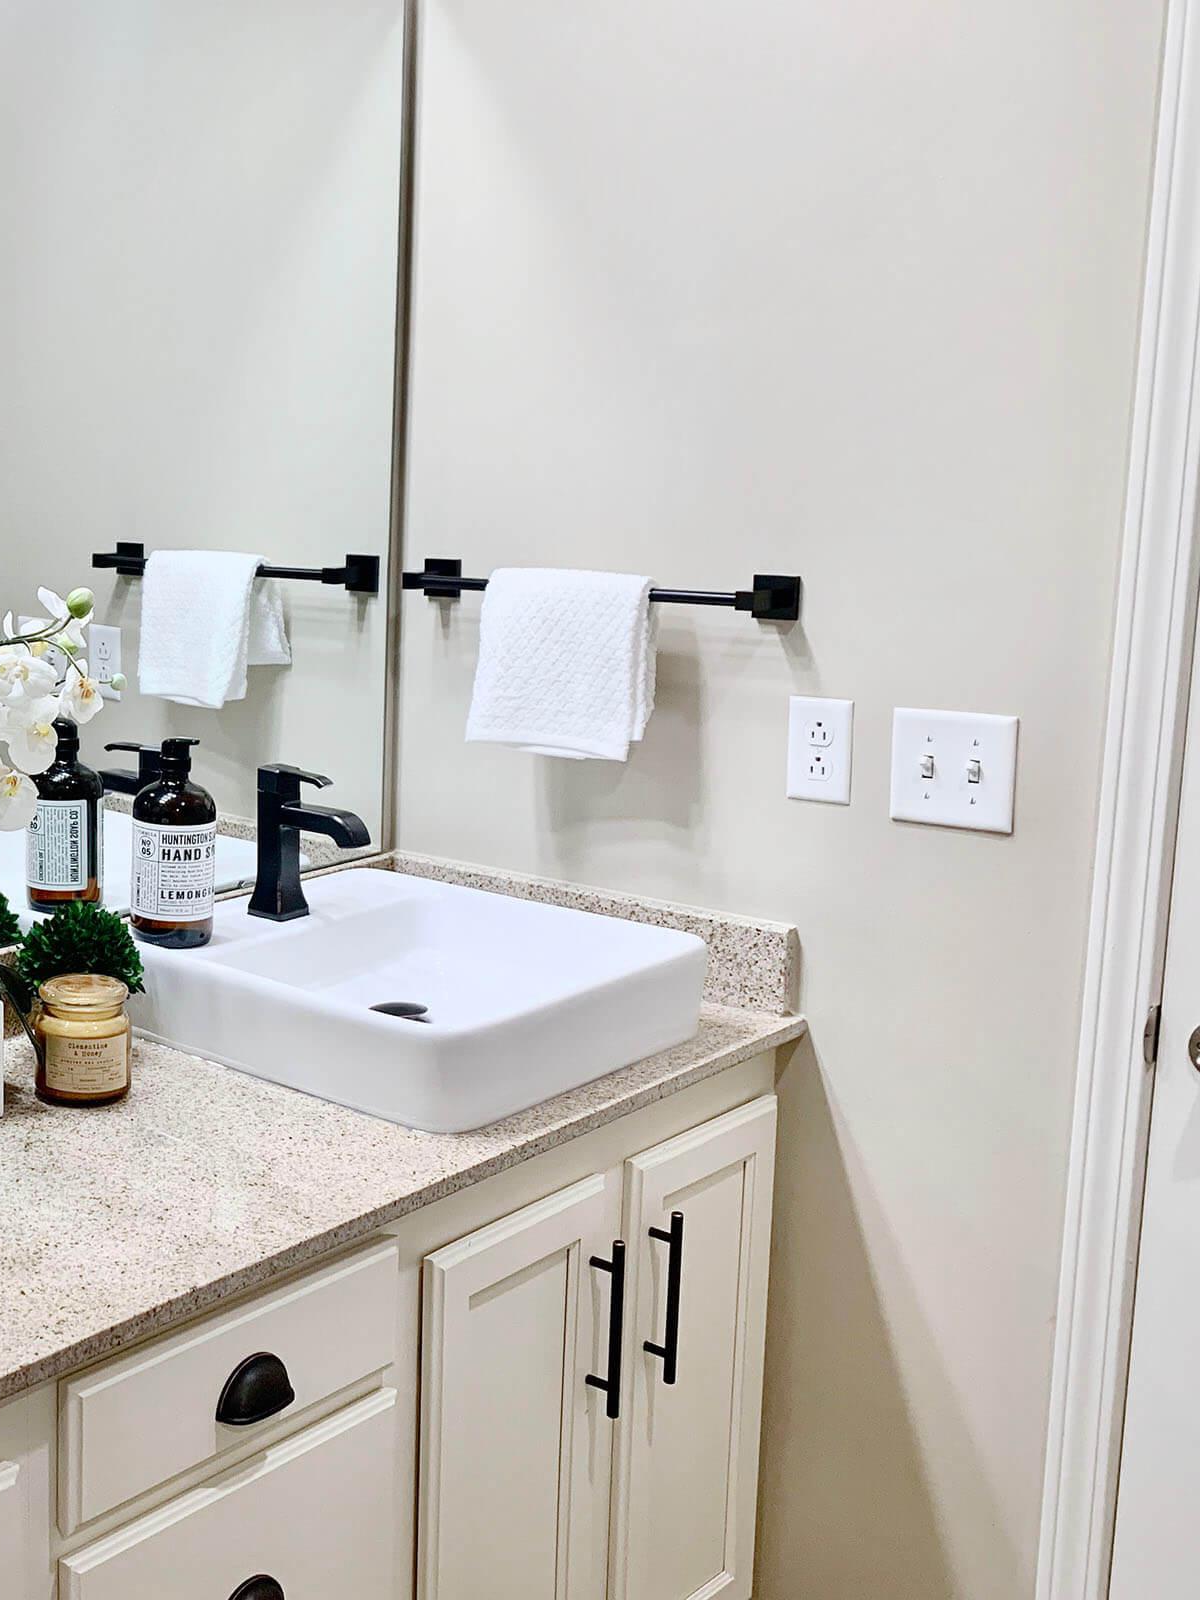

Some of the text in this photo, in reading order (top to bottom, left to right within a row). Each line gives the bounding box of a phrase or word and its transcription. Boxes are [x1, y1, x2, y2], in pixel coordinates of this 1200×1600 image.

[161, 832, 208, 845] HUNTINGTON
[141, 847, 152, 856] 05
[161, 848, 202, 862] HAND
